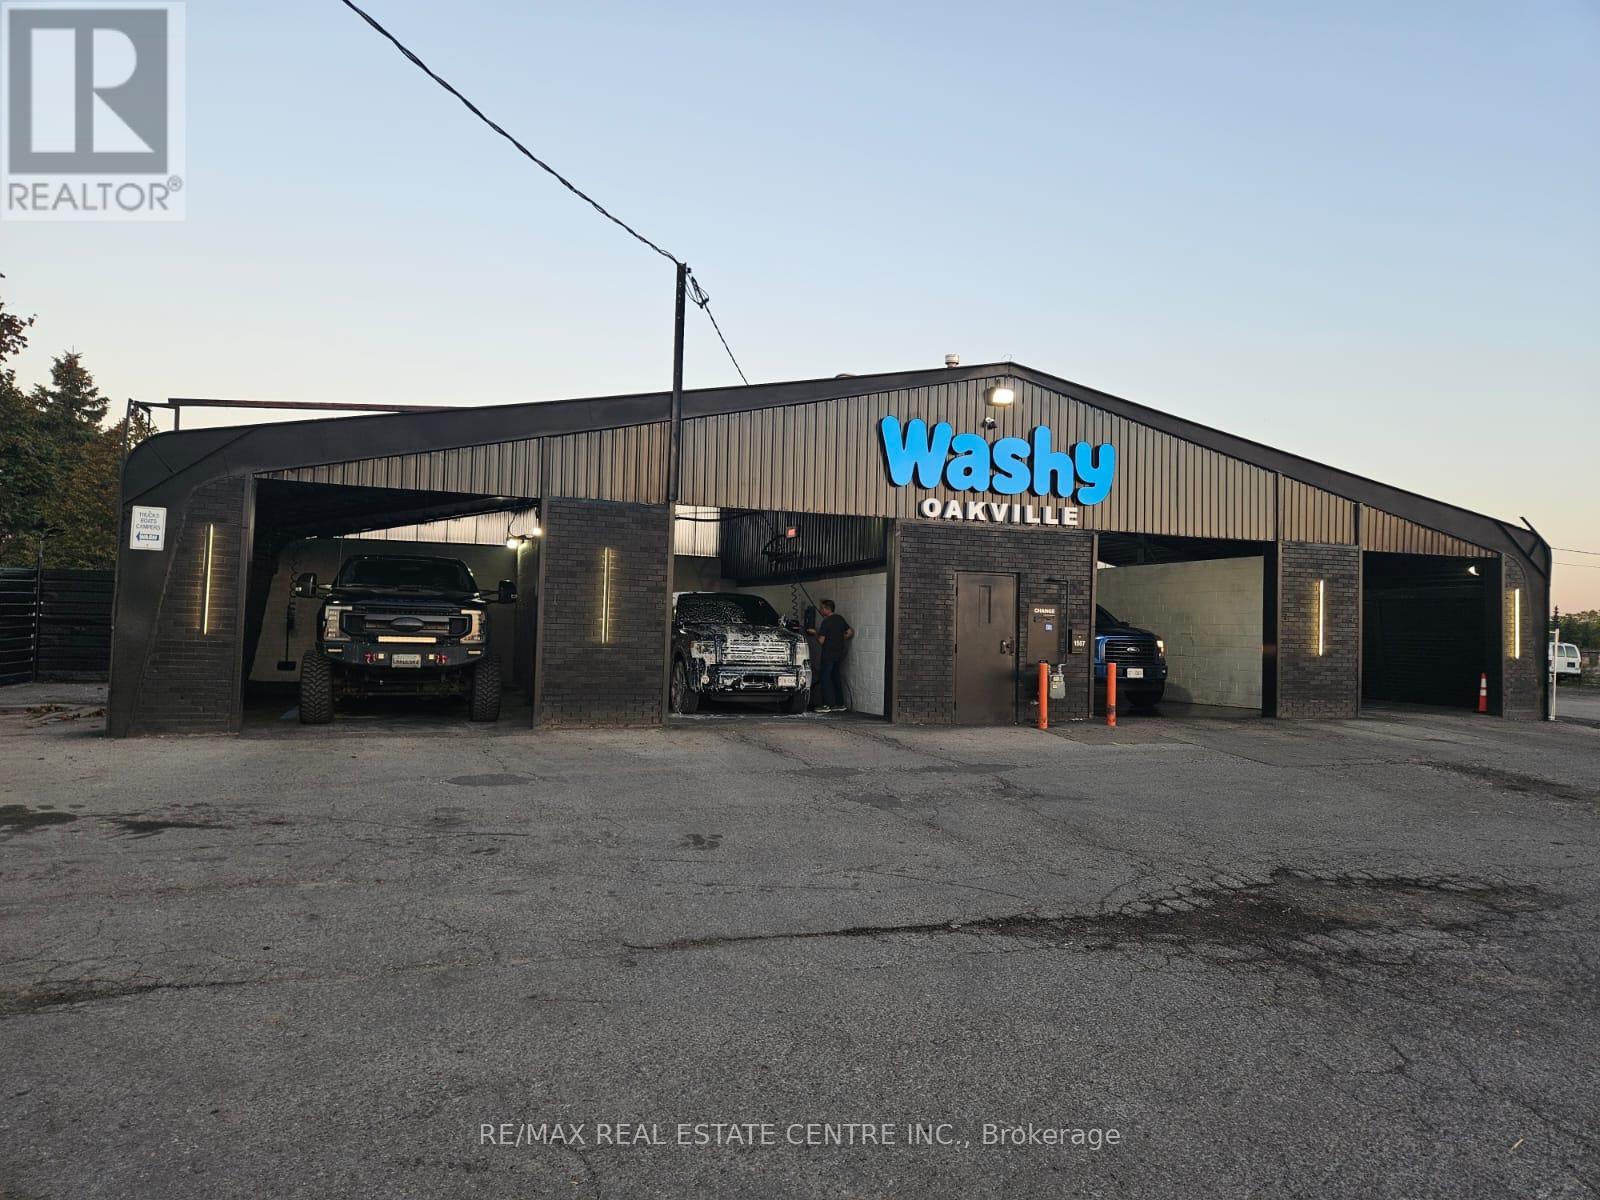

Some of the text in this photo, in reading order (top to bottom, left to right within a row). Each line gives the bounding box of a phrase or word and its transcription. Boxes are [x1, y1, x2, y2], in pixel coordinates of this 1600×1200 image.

[880, 415, 1117, 506] Washy
[135, 523, 161, 531] CAMPERS
[920, 498, 1080, 527] OAKVILLE
